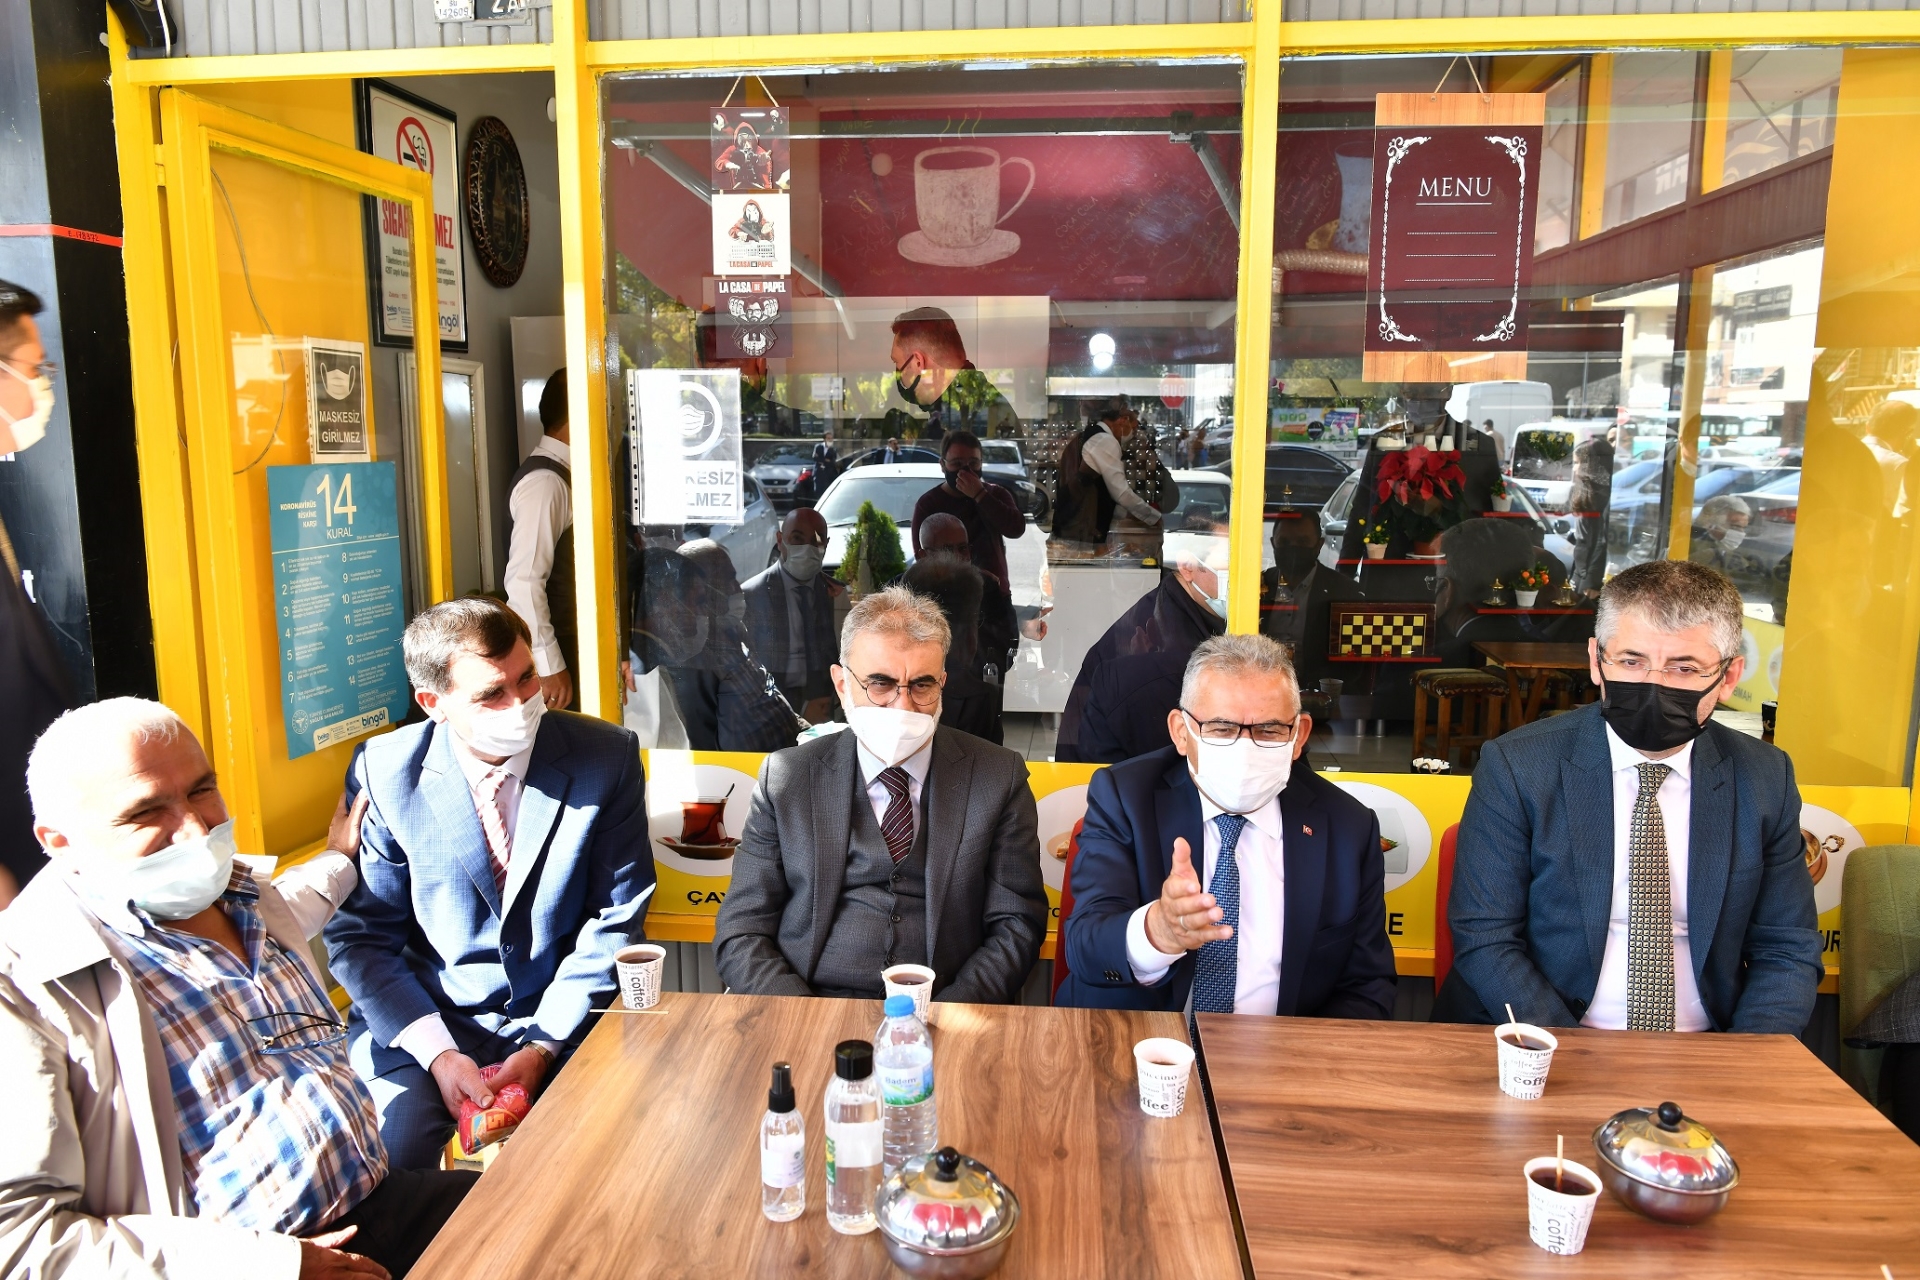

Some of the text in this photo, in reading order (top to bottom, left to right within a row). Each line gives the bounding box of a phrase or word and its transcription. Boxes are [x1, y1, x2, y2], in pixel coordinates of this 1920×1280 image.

[439, 7, 469, 17] 142609
[1418, 177, 1492, 197] MENU
[434, 213, 454, 249] MEZ
[719, 282, 729, 293] LA
[730, 282, 752, 293] CASA
[763, 282, 786, 293] PAPEL
[438, 314, 459, 332] ingöl
[320, 410, 360, 423] MASKESİZ
[322, 429, 361, 443] GİRİLMEZ
[685, 469, 735, 486] KESİZ
[316, 473, 357, 527] 14
[326, 527, 354, 540] KURAL
[342, 552, 347, 563] 8
[281, 562, 286, 573] 1
[343, 573, 349, 583] 9
[282, 584, 288, 595] 2
[342, 593, 350, 604] 10
[284, 606, 290, 617] 3
[344, 615, 351, 625] 11
[285, 628, 291, 638] 4
[345, 634, 354, 645] 12
[287, 650, 293, 661] 5
[347, 655, 355, 666] 13
[287, 671, 294, 682] 6
[289, 692, 295, 704] 7
[362, 709, 386, 727] bingöl
[1388, 913, 1403, 935] E
[1819, 930, 1840, 952] UR
[631, 977, 646, 1009] coffee
[1141, 1096, 1169, 1110] ffee
